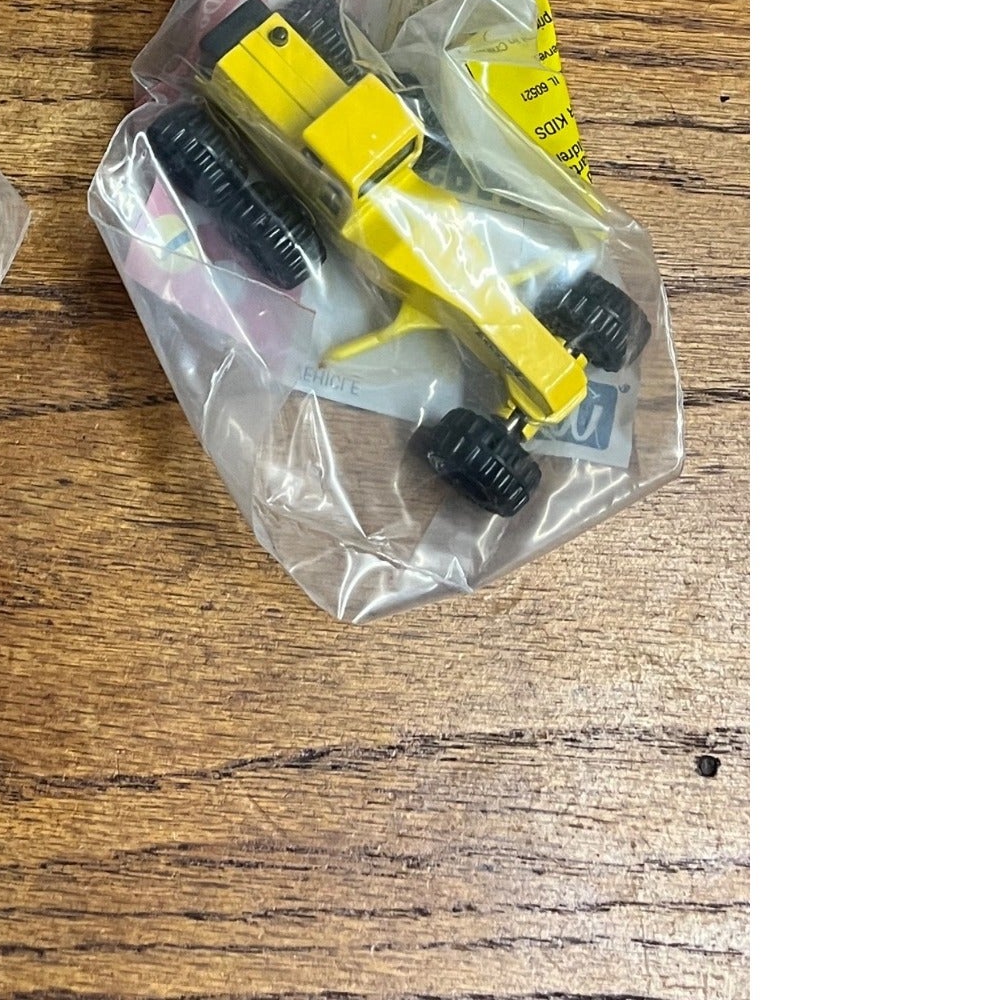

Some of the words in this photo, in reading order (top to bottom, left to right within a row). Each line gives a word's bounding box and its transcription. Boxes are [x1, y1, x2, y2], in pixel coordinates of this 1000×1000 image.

[520, 81, 549, 103] 60521
[547, 75, 560, 87] IL
[534, 112, 569, 140] KIDS
